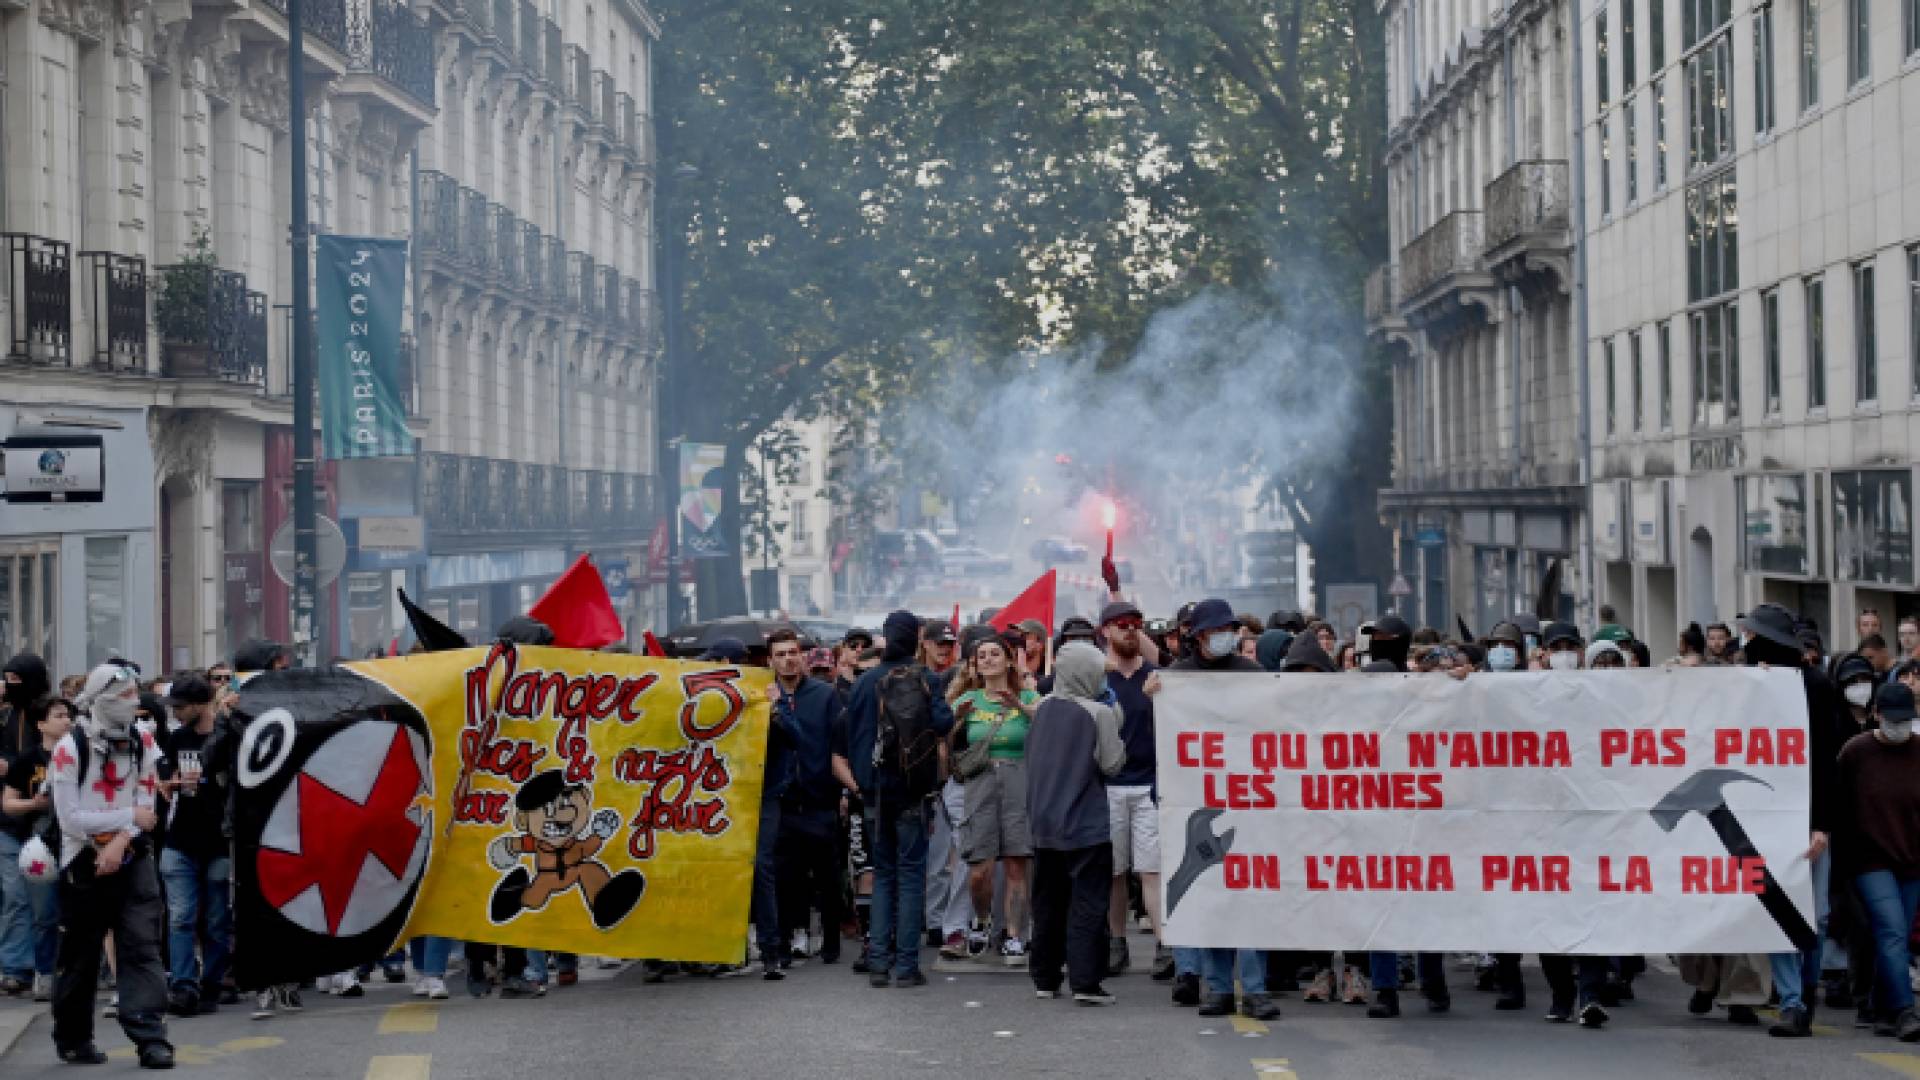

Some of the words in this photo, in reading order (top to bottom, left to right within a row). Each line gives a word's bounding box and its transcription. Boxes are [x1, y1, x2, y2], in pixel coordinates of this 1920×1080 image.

[348, 249, 372, 337] 2024
[350, 349, 378, 444] PARIS
[466, 639, 659, 760] Manger
[680, 669, 744, 742] 5
[566, 737, 598, 784] &
[1177, 732, 1225, 768] CE
[1408, 731, 1571, 769] N'AURA
[1599, 729, 1687, 767] PAS
[1715, 728, 1806, 766] PAR
[1203, 774, 1276, 810] LES
[1300, 773, 1443, 811] URNES
[628, 792, 731, 859] jour
[1223, 854, 1281, 890] ON
[1305, 855, 1454, 891] L'AURA
[1481, 855, 1571, 892] PAR
[1599, 856, 1653, 893] LA
[1681, 857, 1766, 894] RUE
